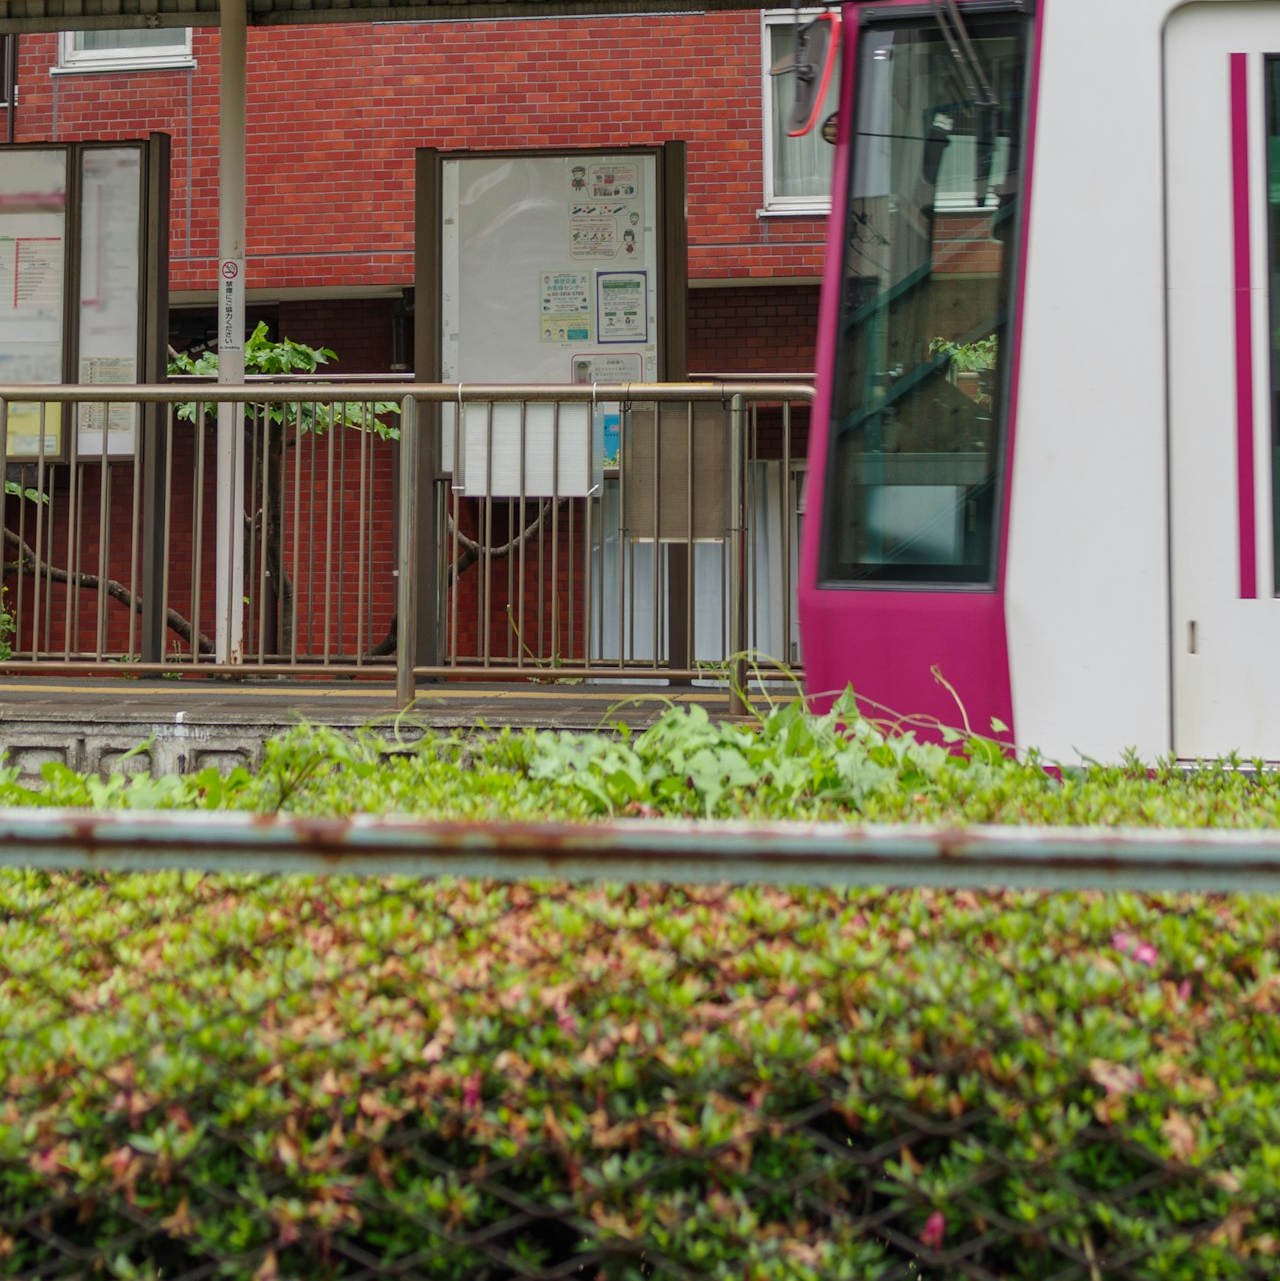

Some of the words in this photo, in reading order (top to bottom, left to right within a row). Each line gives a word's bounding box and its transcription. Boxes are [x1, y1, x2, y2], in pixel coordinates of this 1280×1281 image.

[225, 281, 233, 344] 禁煙にご協力ください
